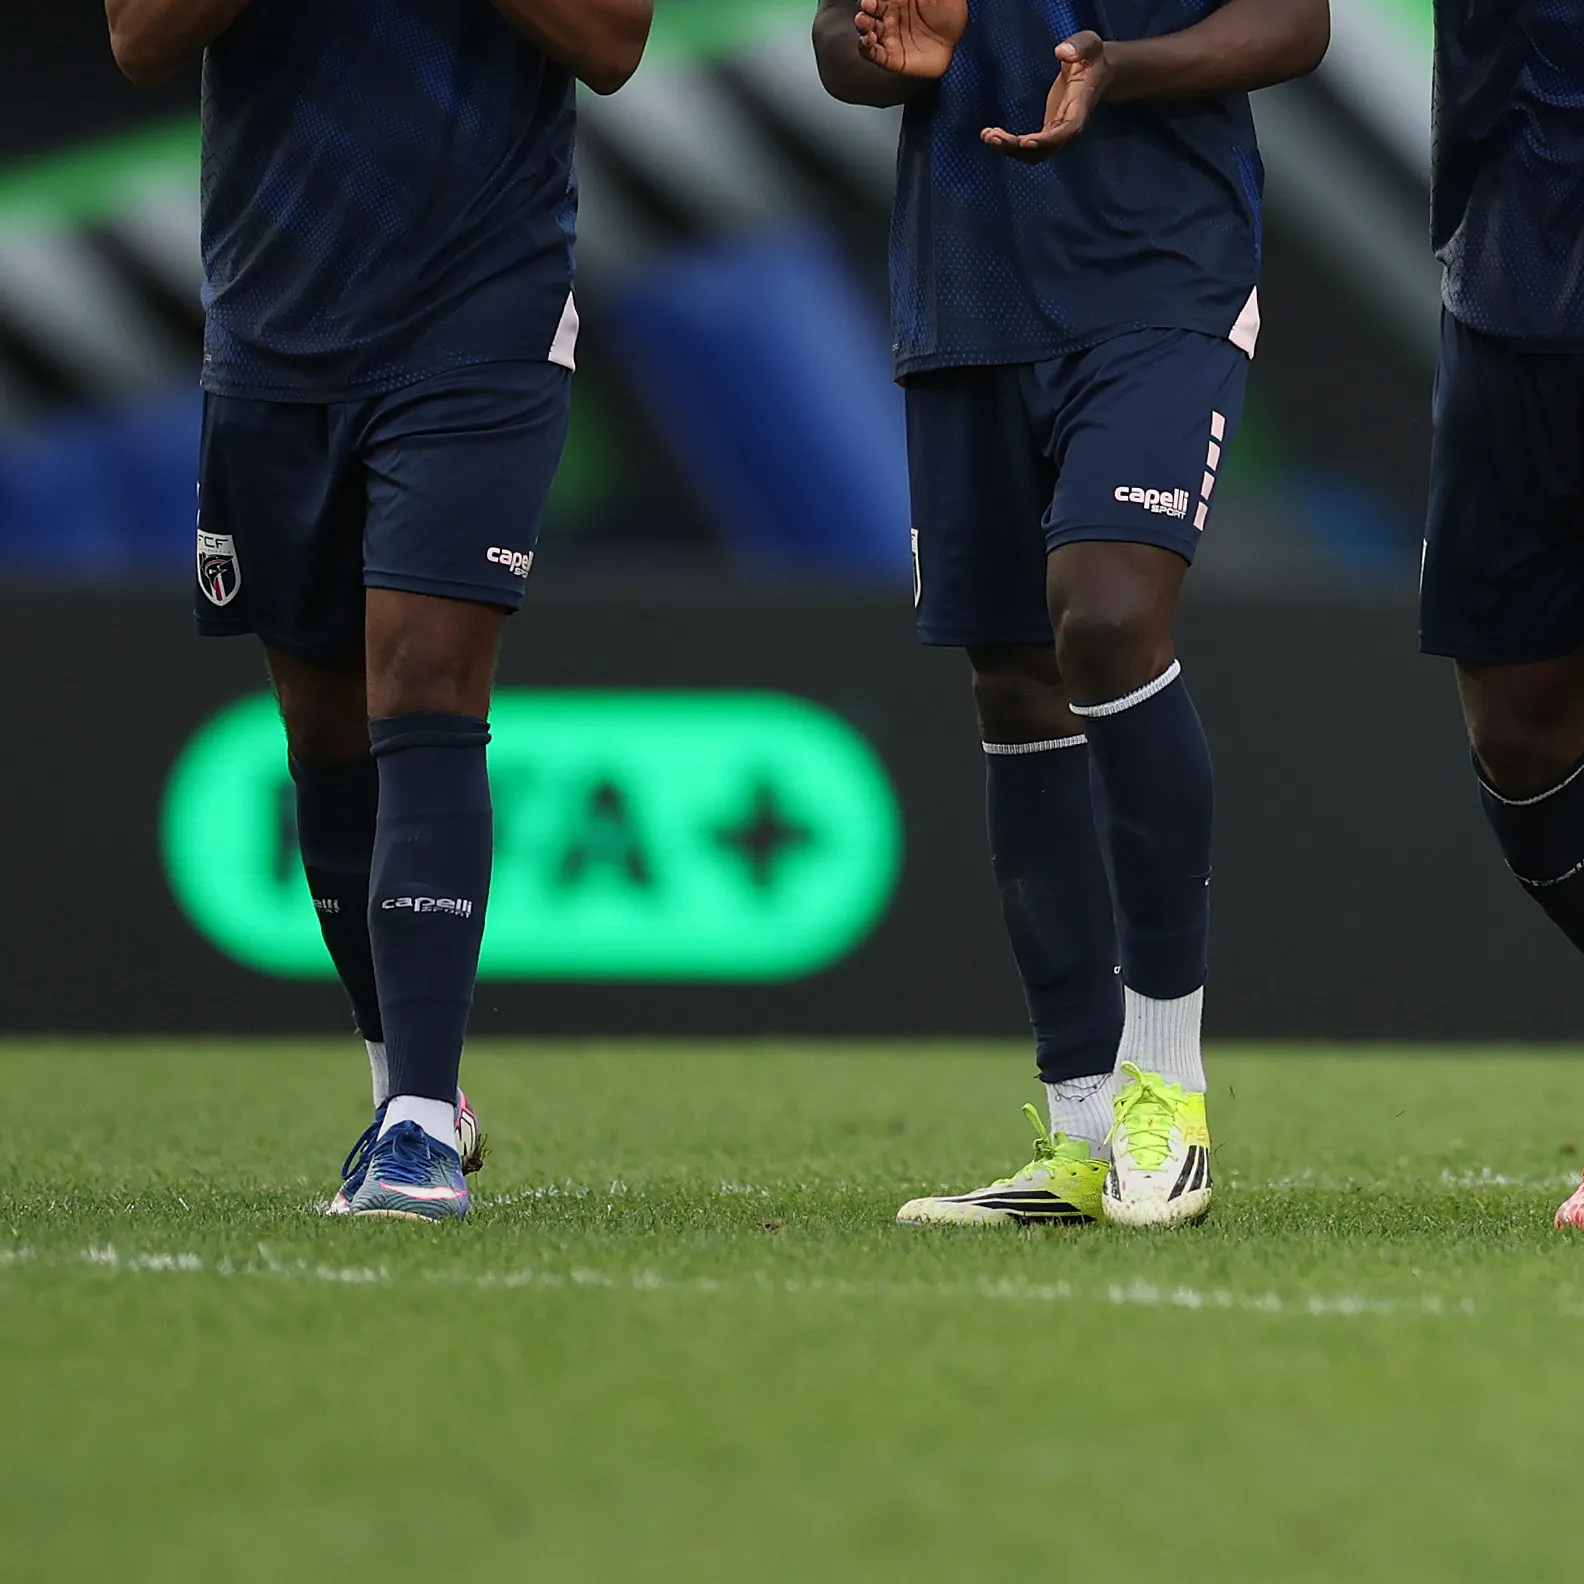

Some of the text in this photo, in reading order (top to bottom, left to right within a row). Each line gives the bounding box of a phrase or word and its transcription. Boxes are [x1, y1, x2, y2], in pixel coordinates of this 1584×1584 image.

[1114, 486, 1189, 512] capelli
[1150, 504, 1187, 520] SPORT
[486, 546, 535, 573] capel
[381, 896, 474, 913] capelli
